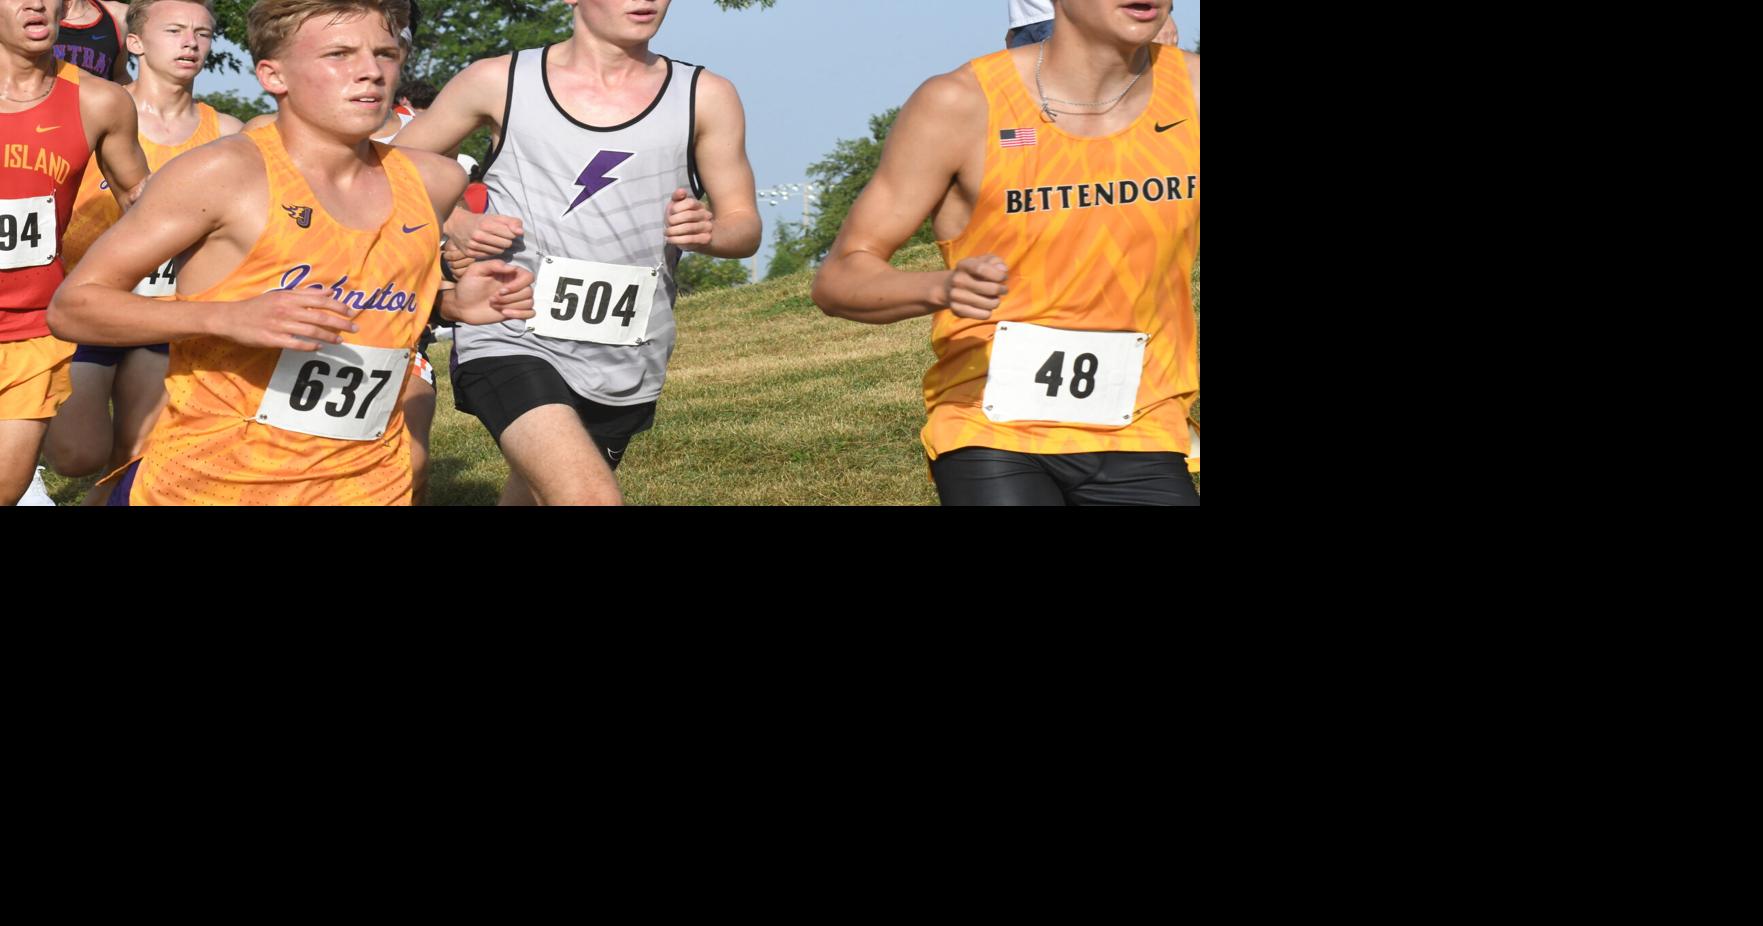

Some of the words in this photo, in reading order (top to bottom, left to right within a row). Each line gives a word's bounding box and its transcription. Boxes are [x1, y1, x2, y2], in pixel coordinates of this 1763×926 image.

[53, 44, 111, 75] NTRA
[4, 144, 71, 185] ISLAND
[1006, 175, 1197, 214] BETTENDORF
[0, 211, 42, 251] 94
[550, 276, 639, 327] 504
[289, 360, 393, 419] 637
[1034, 350, 1098, 399] 48
